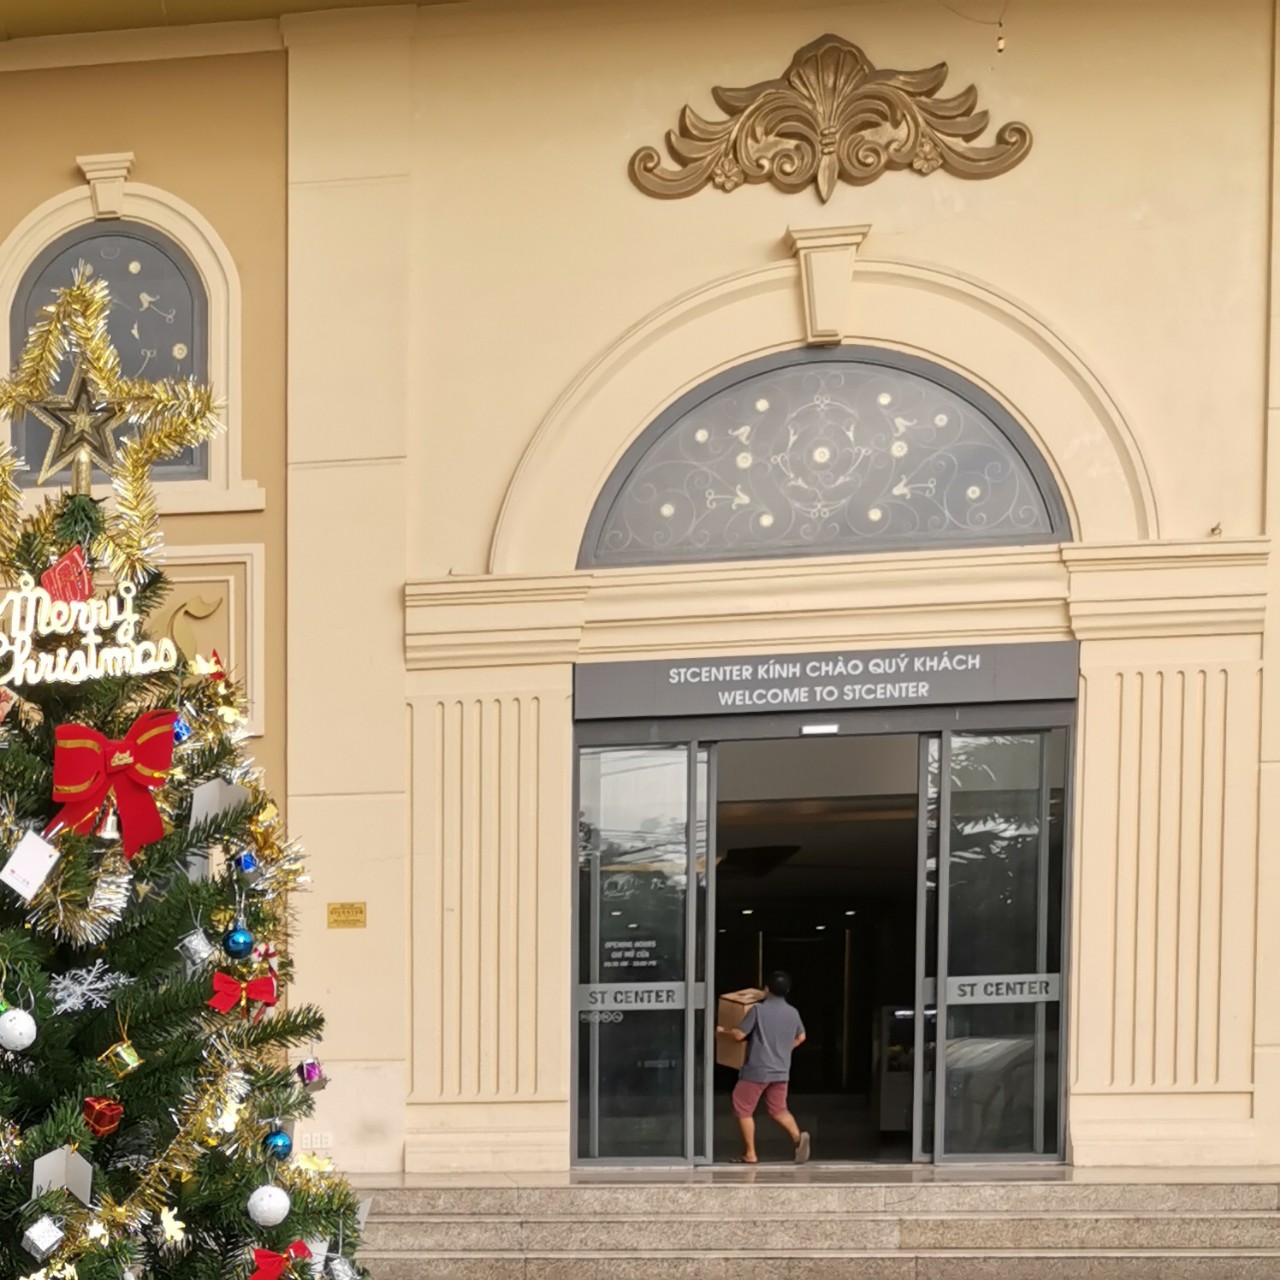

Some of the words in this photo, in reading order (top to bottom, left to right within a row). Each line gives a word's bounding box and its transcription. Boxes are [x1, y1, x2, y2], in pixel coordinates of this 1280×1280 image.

[668, 664, 753, 684] STCENTER
[757, 659, 801, 680] KÍNH
[805, 656, 864, 678] CHÀO
[868, 653, 910, 675] QUÝ
[913, 651, 981, 673] KHÁCH
[718, 686, 810, 706] WELCOME
[814, 684, 839, 703] TO
[842, 681, 930, 701] STCENTER
[588, 990, 609, 1005] ST
[613, 989, 676, 1005] CENTER
[957, 982, 978, 998] ST
[983, 980, 1050, 997] CENTER
